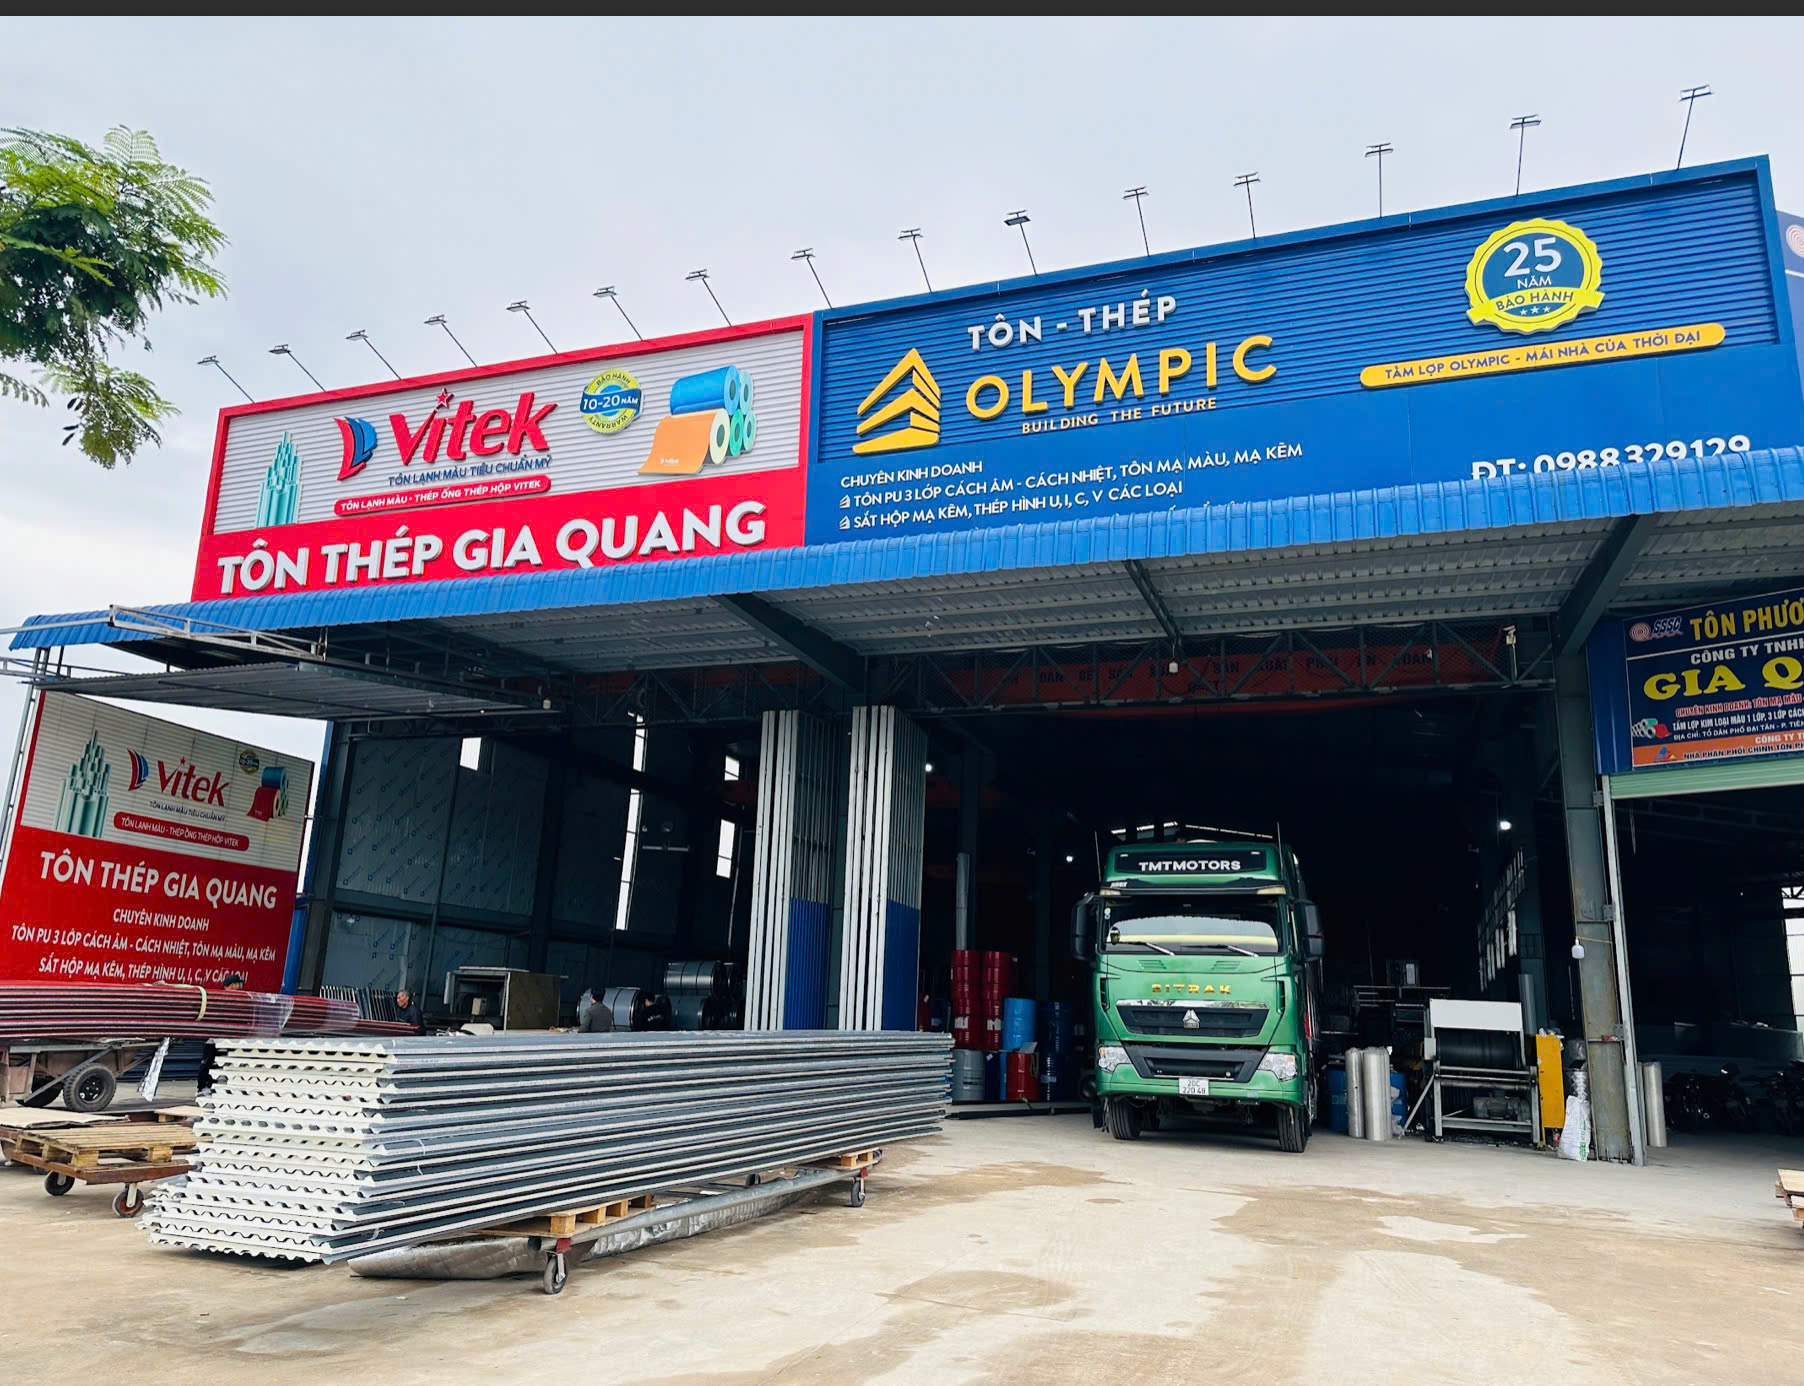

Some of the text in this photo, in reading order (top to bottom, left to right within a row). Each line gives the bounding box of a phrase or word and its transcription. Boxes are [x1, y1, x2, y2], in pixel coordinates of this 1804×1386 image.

[1503, 237, 1562, 277] 25
[1517, 275, 1552, 289] NĂM
[1496, 289, 1574, 311] BẢO HÀNH
[968, 288, 1176, 351] TÔN THÉP
[1419, 362, 1444, 376] LỢP
[1450, 354, 1510, 371] OLYMPIC
[1526, 347, 1553, 362] MÁI
[1558, 342, 1590, 359] NHÀ
[1595, 338, 1627, 353] CỦA
[1633, 332, 1668, 349] THỜI
[1674, 330, 1700, 346] ĐẠI
[966, 335, 1277, 419] OLYMPIC
[583, 395, 620, 410] 10-20
[1022, 397, 1217, 434] BUILDING THE FUTURE
[840, 460, 983, 488] CHUYÊN KINH DOANH
[854, 442, 1303, 507] TÔN PU 3 LỚP CÁCH ÂM CÁCH NHIỆT, TÔN MẠ MÀU, MẠ KẼM
[341, 500, 360, 511] TÔN
[361, 498, 386, 511] LẠNH
[387, 494, 408, 506] MÀU
[414, 489, 439, 505] THÉP
[464, 483, 489, 498] THÉP
[490, 481, 511, 496] HỘP
[514, 479, 541, 491] VITEK
[854, 510, 877, 528] SẮT
[881, 509, 910, 528] HỘP
[913, 508, 935, 523] MẠ
[974, 498, 1009, 516] THÉP
[1012, 494, 1046, 512] HÌNH
[1049, 495, 1063, 509] U,
[1074, 491, 1089, 506] C,
[1092, 490, 1103, 503] V
[1108, 484, 1141, 501] CÁC
[1145, 480, 1182, 498] LOẠI
[217, 500, 767, 594] TÔN THÉP GIA QUANG
[1690, 609, 1736, 641] TÔN
[1690, 647, 1735, 665] CÔNG
[1740, 645, 1760, 658] TY
[1643, 655, 1804, 701] GIA Q
[40, 847, 277, 909] TÔN THÉP GIA QUANG
[1139, 860, 1241, 872] TMTMOTORS
[113, 907, 210, 931] CHUYÊN KINH DOANH
[12, 922, 36, 942] TÔN
[36, 927, 52, 943] PU
[52, 929, 60, 945] 3
[61, 927, 82, 946] LỚP
[83, 930, 112, 949] CÁCH
[112, 932, 128, 950] ÂM
[135, 935, 161, 954] CÁCH
[192, 940, 211, 957] TÔN
[210, 945, 224, 962] MẠ
[245, 947, 258, 964] MẠ
[39, 952, 59, 973] SẮT
[60, 956, 84, 978] HỘP
[84, 961, 100, 980] MẠ
[127, 962, 151, 980] THÉP
[152, 963, 176, 981] HÌNH
[1151, 983, 1231, 995] SITRAK
